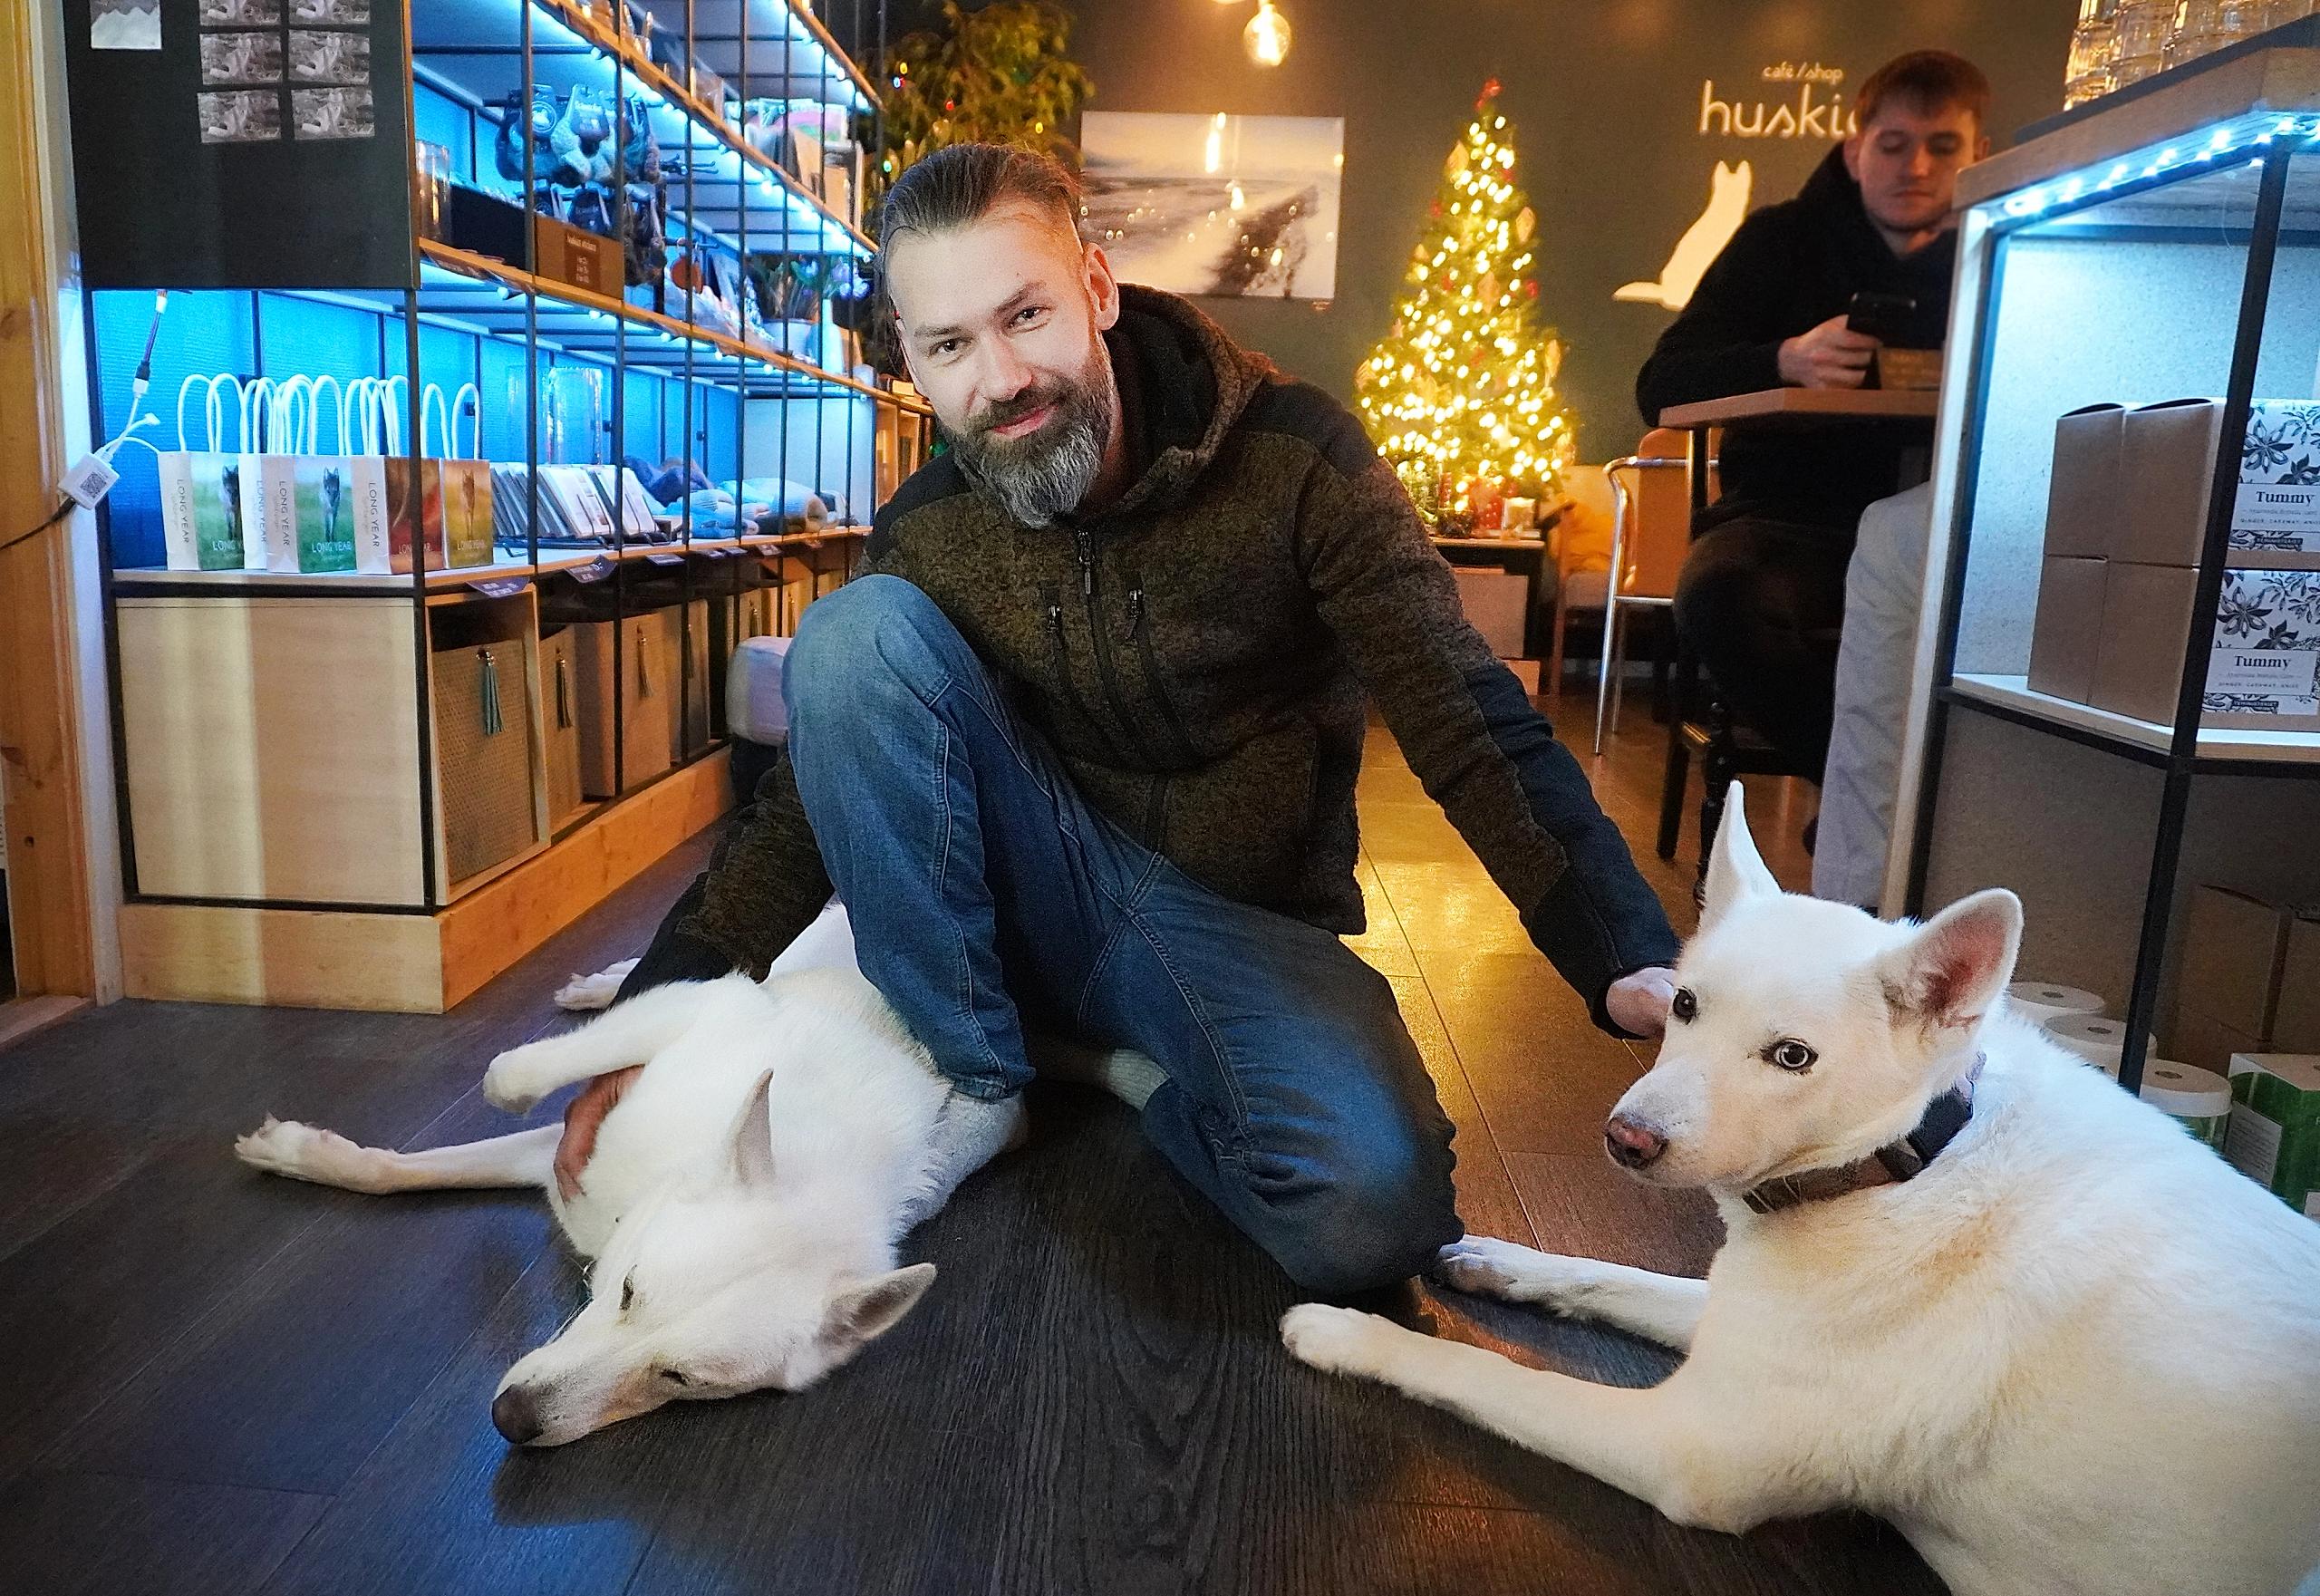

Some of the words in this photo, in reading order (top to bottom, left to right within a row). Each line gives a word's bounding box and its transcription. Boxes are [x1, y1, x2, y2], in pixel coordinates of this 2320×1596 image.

[177, 479, 187, 512] LONG
[279, 480, 288, 514] LONG
[368, 482, 378, 515] LONG
[2256, 490, 2316, 507] Tummy
[181, 516, 189, 544] YEAR
[282, 517, 290, 546] YEAR
[372, 519, 380, 547] YEAR
[399, 543, 413, 555] LON
[2235, 655, 2292, 671] Tummy
